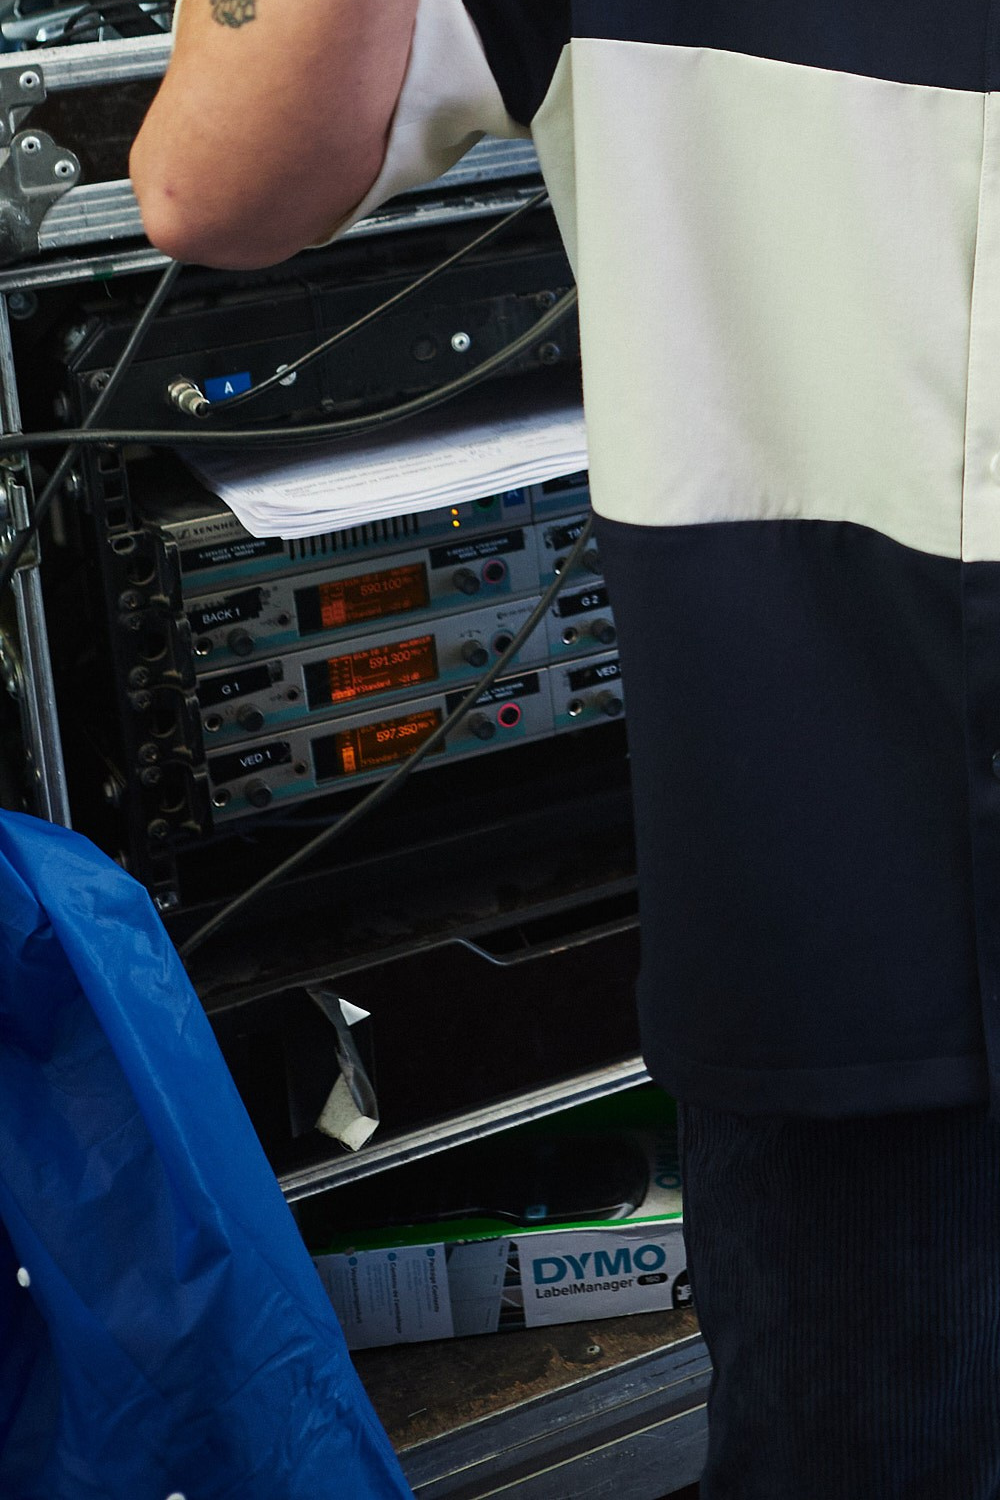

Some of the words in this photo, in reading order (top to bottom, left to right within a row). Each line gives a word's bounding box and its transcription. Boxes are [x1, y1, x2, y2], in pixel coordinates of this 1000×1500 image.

[224, 381, 234, 395] A
[192, 520, 240, 536] SENNHE
[581, 597, 590, 607] G
[592, 595, 599, 604] 2
[202, 609, 233, 625] BACK
[235, 607, 241, 617] 1
[221, 685, 231, 695] G
[234, 682, 240, 692] 1
[240, 753, 263, 768] VED
[265, 750, 272, 760] 1
[532, 1244, 666, 1286] DYMO
[536, 1277, 634, 1299] LabelManager
